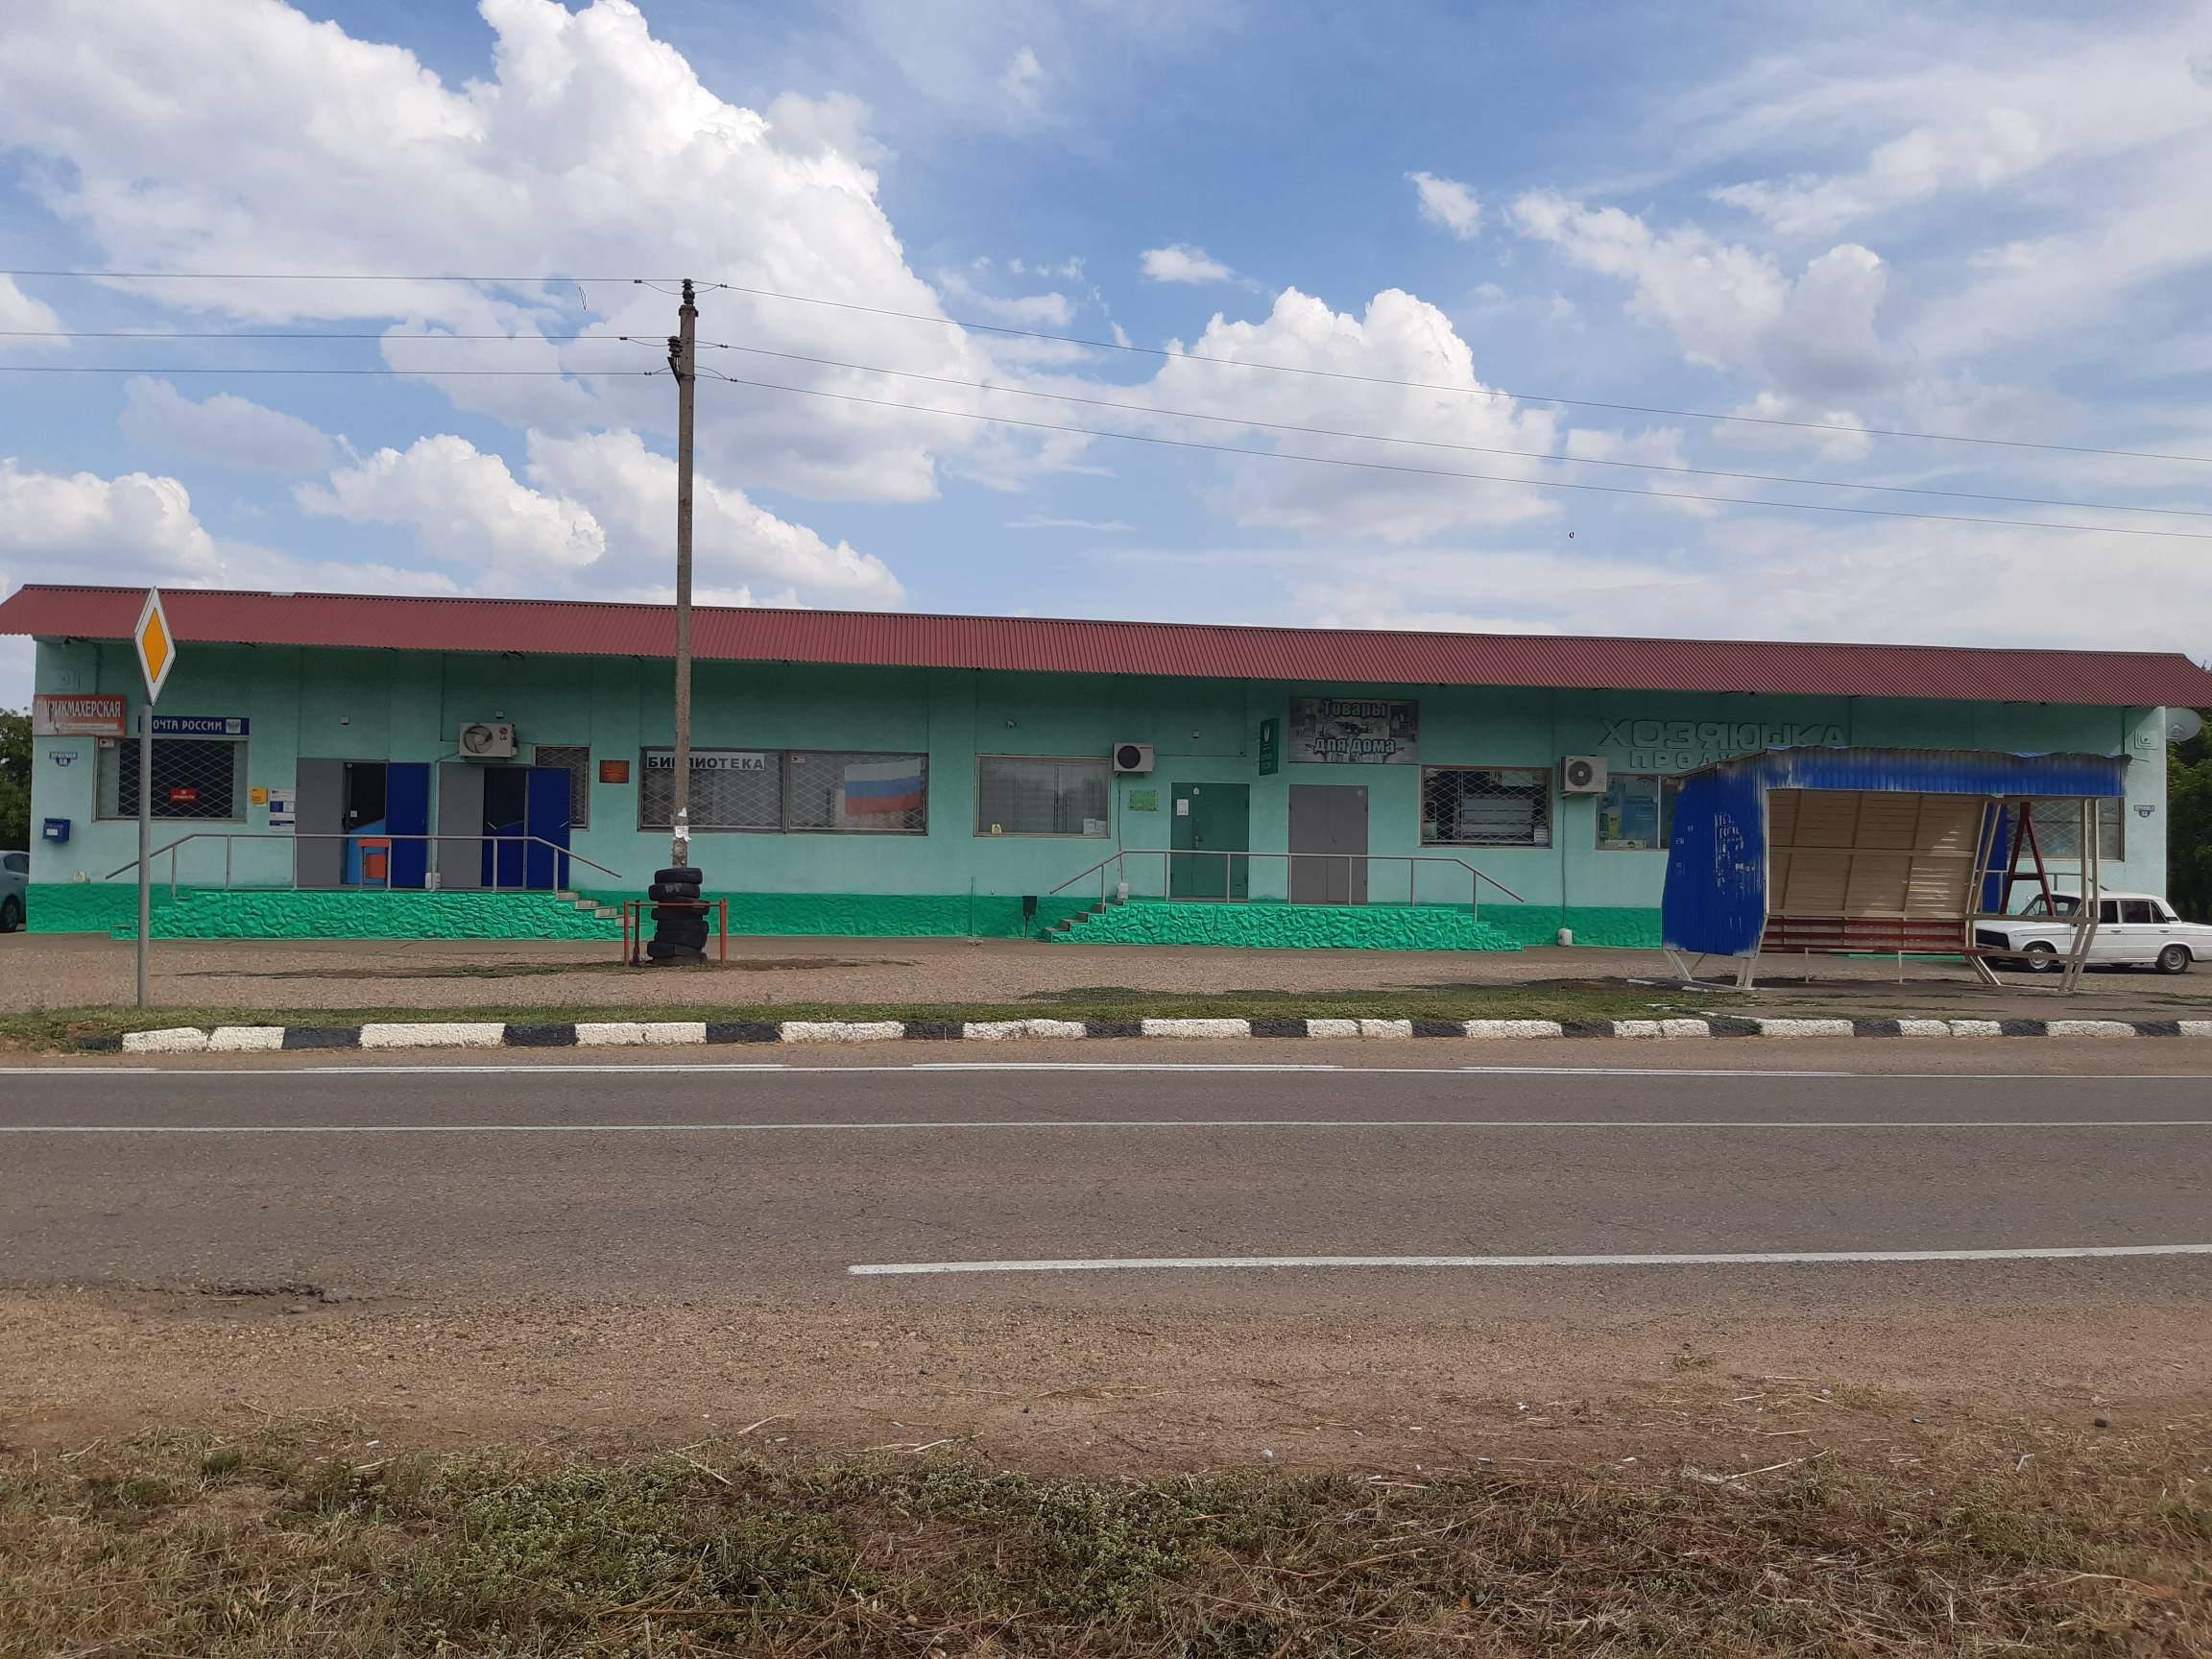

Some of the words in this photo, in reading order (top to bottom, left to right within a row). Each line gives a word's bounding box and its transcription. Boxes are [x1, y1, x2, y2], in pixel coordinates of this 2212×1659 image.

[1323, 700, 1387, 718] Товары
[152, 719, 179, 731] ОЧТА
[181, 720, 223, 732] РОССИИ
[1313, 738, 1348, 754] для
[1351, 739, 1396, 755] дома
